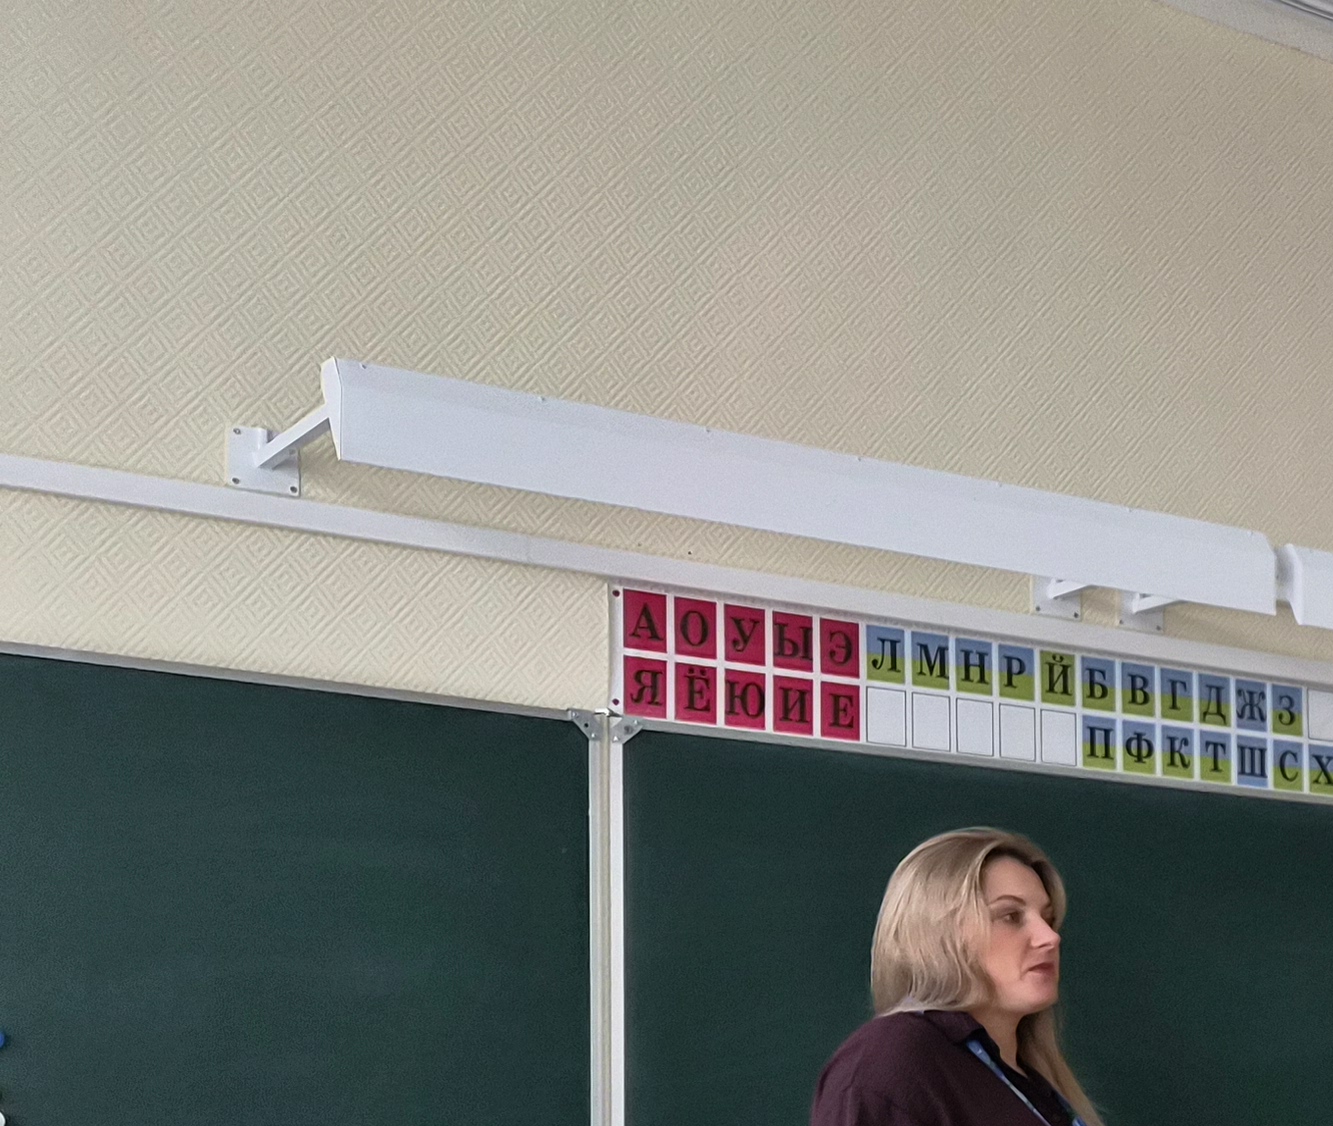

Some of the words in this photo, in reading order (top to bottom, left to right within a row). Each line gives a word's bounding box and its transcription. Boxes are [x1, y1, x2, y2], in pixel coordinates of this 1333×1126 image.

[630, 602, 663, 642] А
[680, 611, 711, 648] О
[730, 618, 760, 652] У
[774, 623, 813, 662] Ы
[828, 630, 853, 666] Э
[871, 637, 902, 673] Л
[916, 642, 950, 681] М
[960, 648, 990, 685] Н
[1003, 654, 1027, 689] Р
[1044, 653, 1074, 697] Й
[1084, 668, 1110, 701] Б
[1127, 673, 1151, 706] В
[1167, 679, 1189, 711] Г
[1202, 684, 1227, 726] Д
[1236, 688, 1268, 722] Ж
[1278, 694, 1296, 726] З
[630, 669, 664, 706] Я
[684, 667, 712, 713] Ё
[724, 680, 766, 720] Ю
[778, 685, 811, 724] И
[828, 694, 855, 730] Е
[1087, 725, 1115, 760] П
[1125, 731, 1155, 764] Ф
[1166, 736, 1191, 770] К
[1204, 741, 1227, 773] Т
[1237, 745, 1268, 779] Ш
[1279, 750, 1298, 783] С
